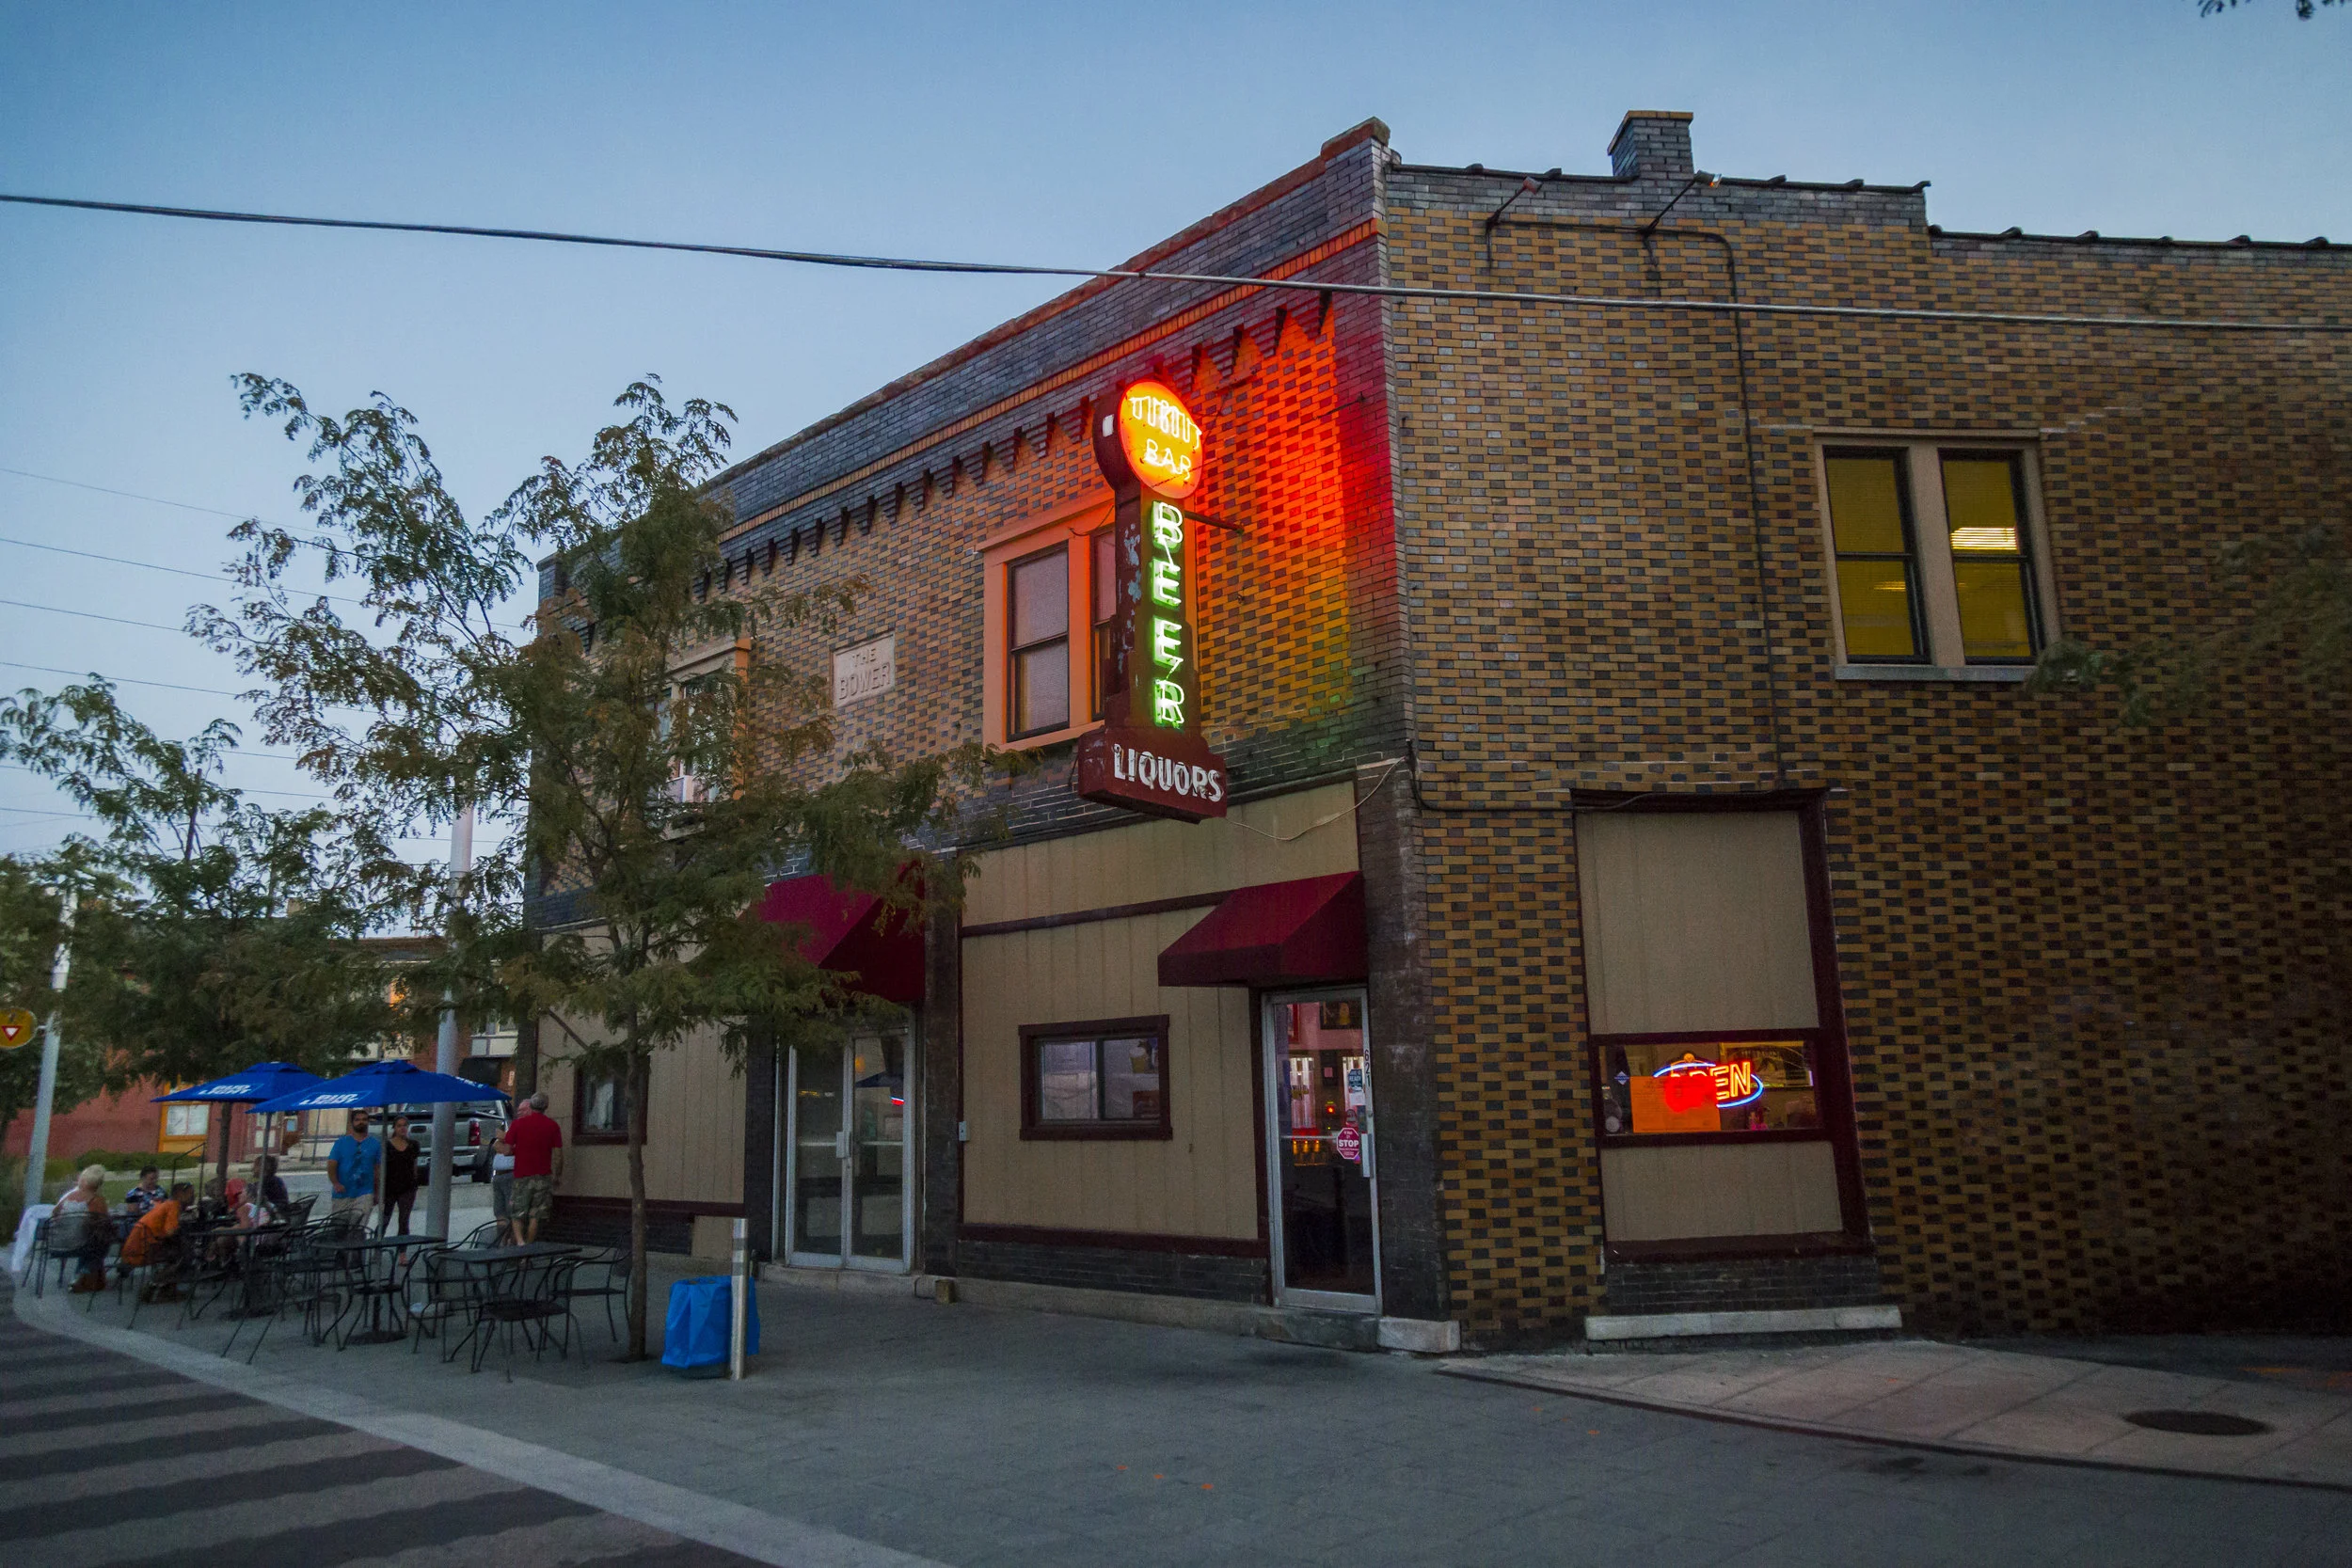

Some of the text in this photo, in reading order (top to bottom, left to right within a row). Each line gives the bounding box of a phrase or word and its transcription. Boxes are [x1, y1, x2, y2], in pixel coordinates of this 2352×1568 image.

[1144, 438, 1192, 481] BAR
[1151, 500, 1184, 732] BEER
[1113, 743, 1224, 802] LIQUORS
[1339, 1139, 1359, 1148] STOP
